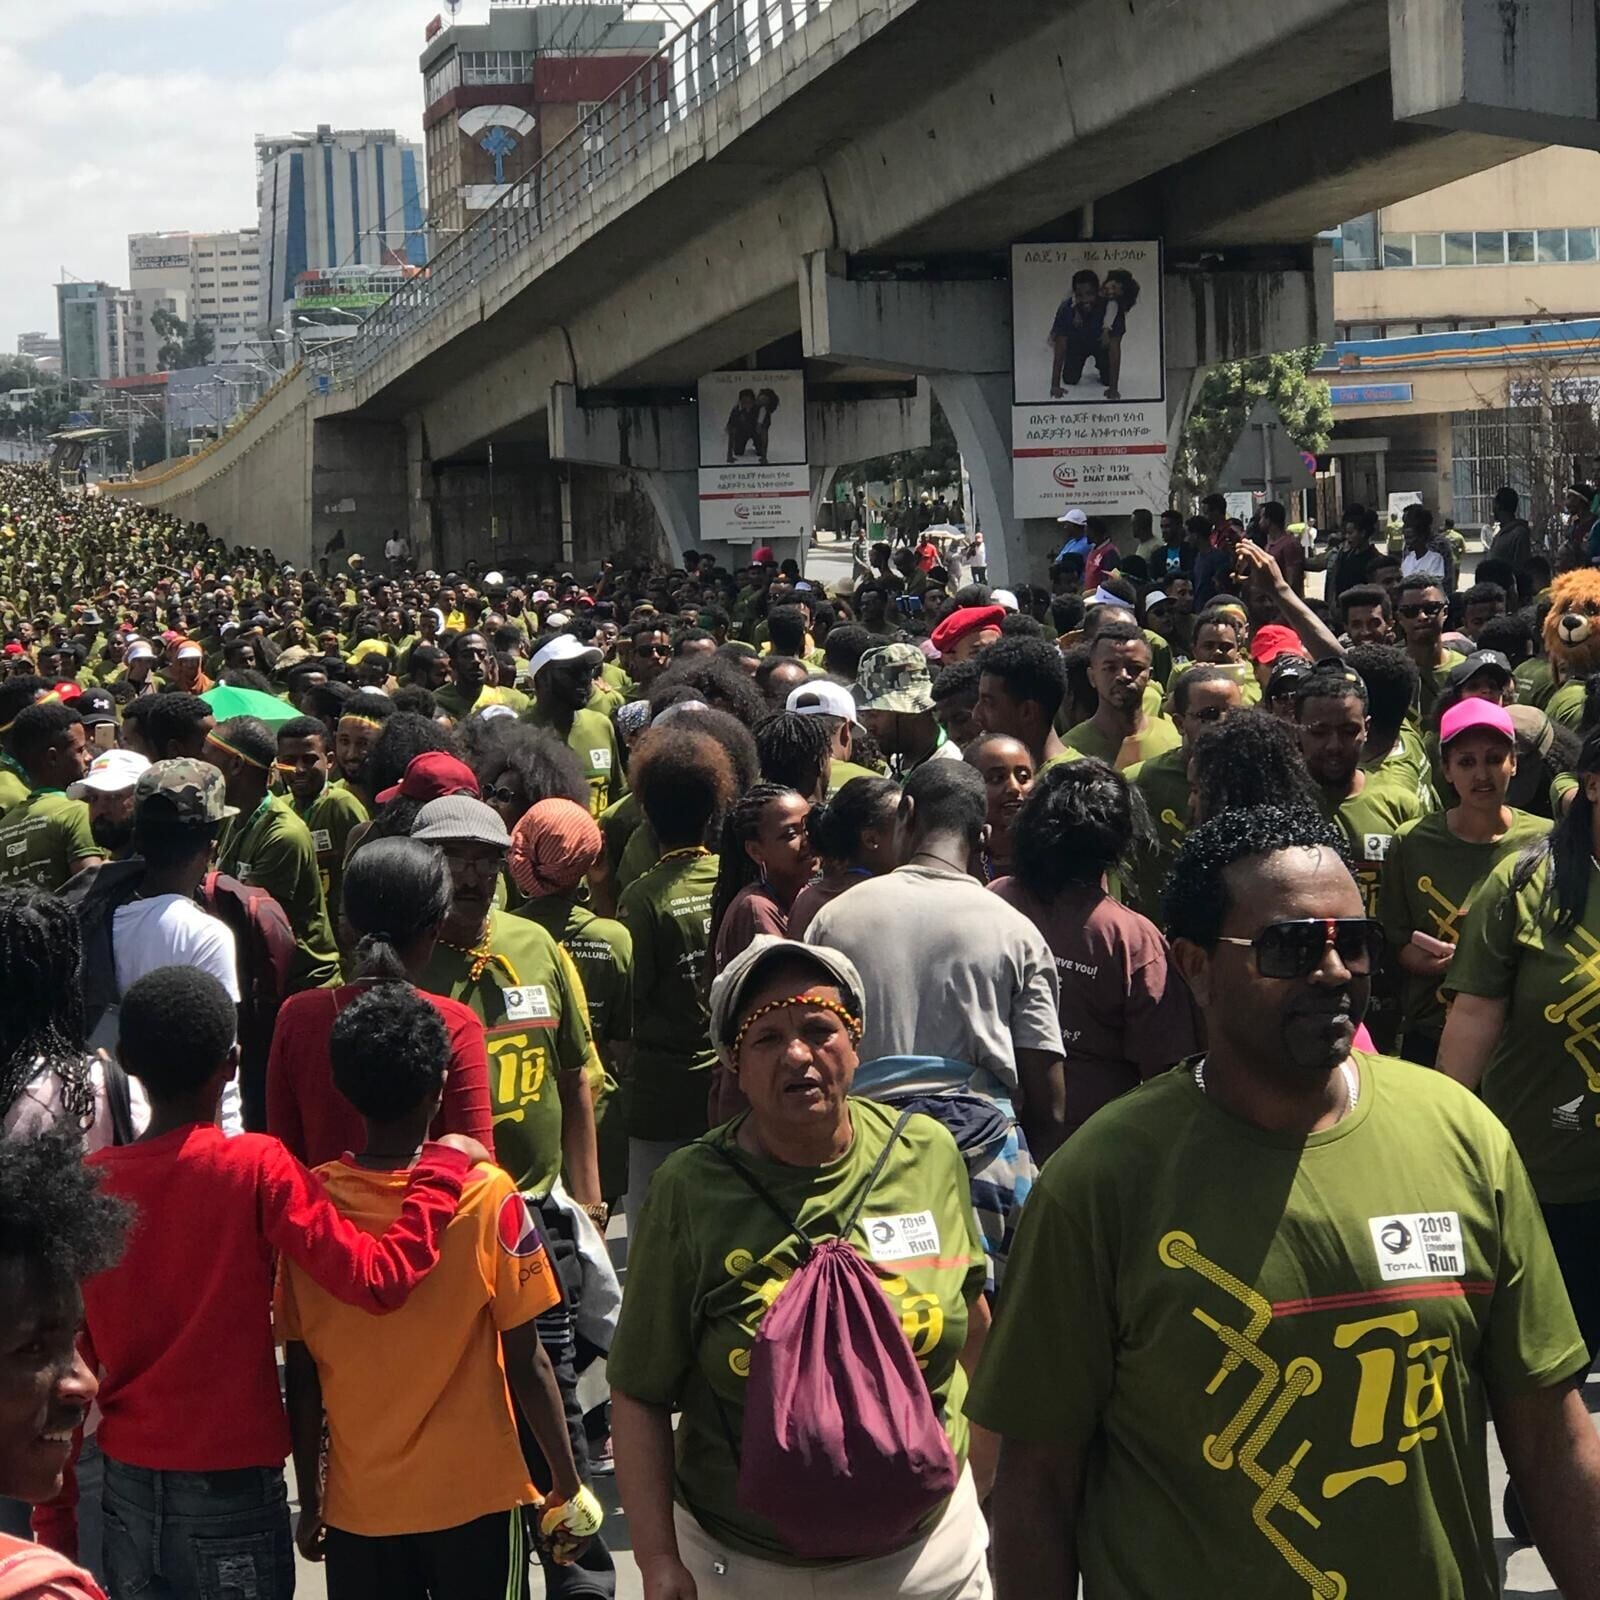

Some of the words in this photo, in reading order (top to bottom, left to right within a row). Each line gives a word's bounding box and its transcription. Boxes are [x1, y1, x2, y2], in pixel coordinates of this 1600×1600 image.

[1083, 474, 1104, 483] ENAT
[1107, 473, 1131, 482] BANK
[572, 940, 582, 948] be
[584, 941, 612, 952] equally
[576, 951, 612, 962] VALUED!
[1075, 962, 1098, 980] YOU!
[899, 1215, 927, 1229] 2019
[1419, 1215, 1452, 1233] 2019
[908, 1238, 937, 1254] Run
[1427, 1253, 1459, 1273] Run
